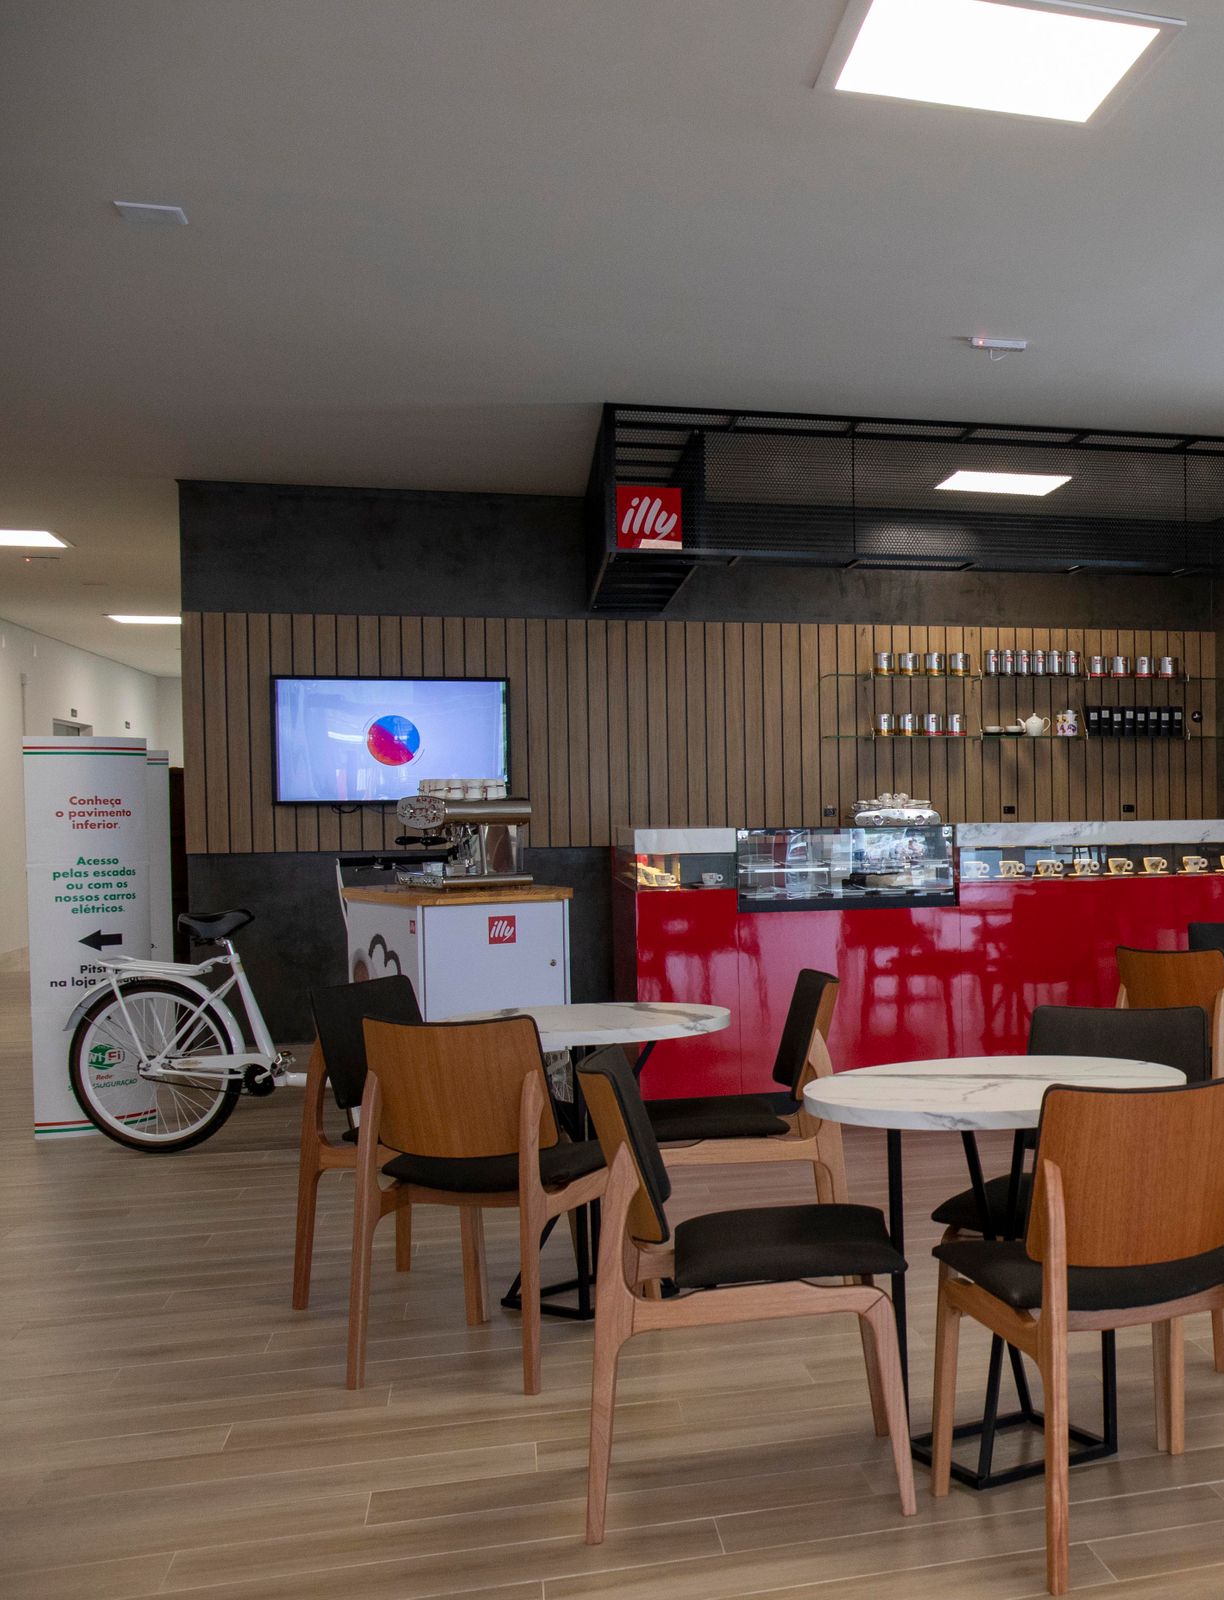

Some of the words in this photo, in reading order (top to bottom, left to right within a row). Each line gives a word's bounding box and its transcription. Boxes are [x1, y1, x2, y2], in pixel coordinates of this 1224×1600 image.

[621, 496, 678, 540] illy
[69, 795, 122, 808] Conheça
[55, 810, 64, 818] o
[68, 808, 132, 820] pavimento
[72, 820, 121, 829] inferior.
[76, 856, 119, 866] Acesso
[52, 868, 89, 881] pelas
[92, 867, 136, 877] escadas
[87, 881, 113, 889] com
[54, 894, 100, 903] nossos
[103, 892, 136, 901] carros
[71, 903, 125, 914] elétricos.
[490, 919, 514, 942] illy
[50, 980, 67, 988] na
[71, 977, 97, 988] loja
